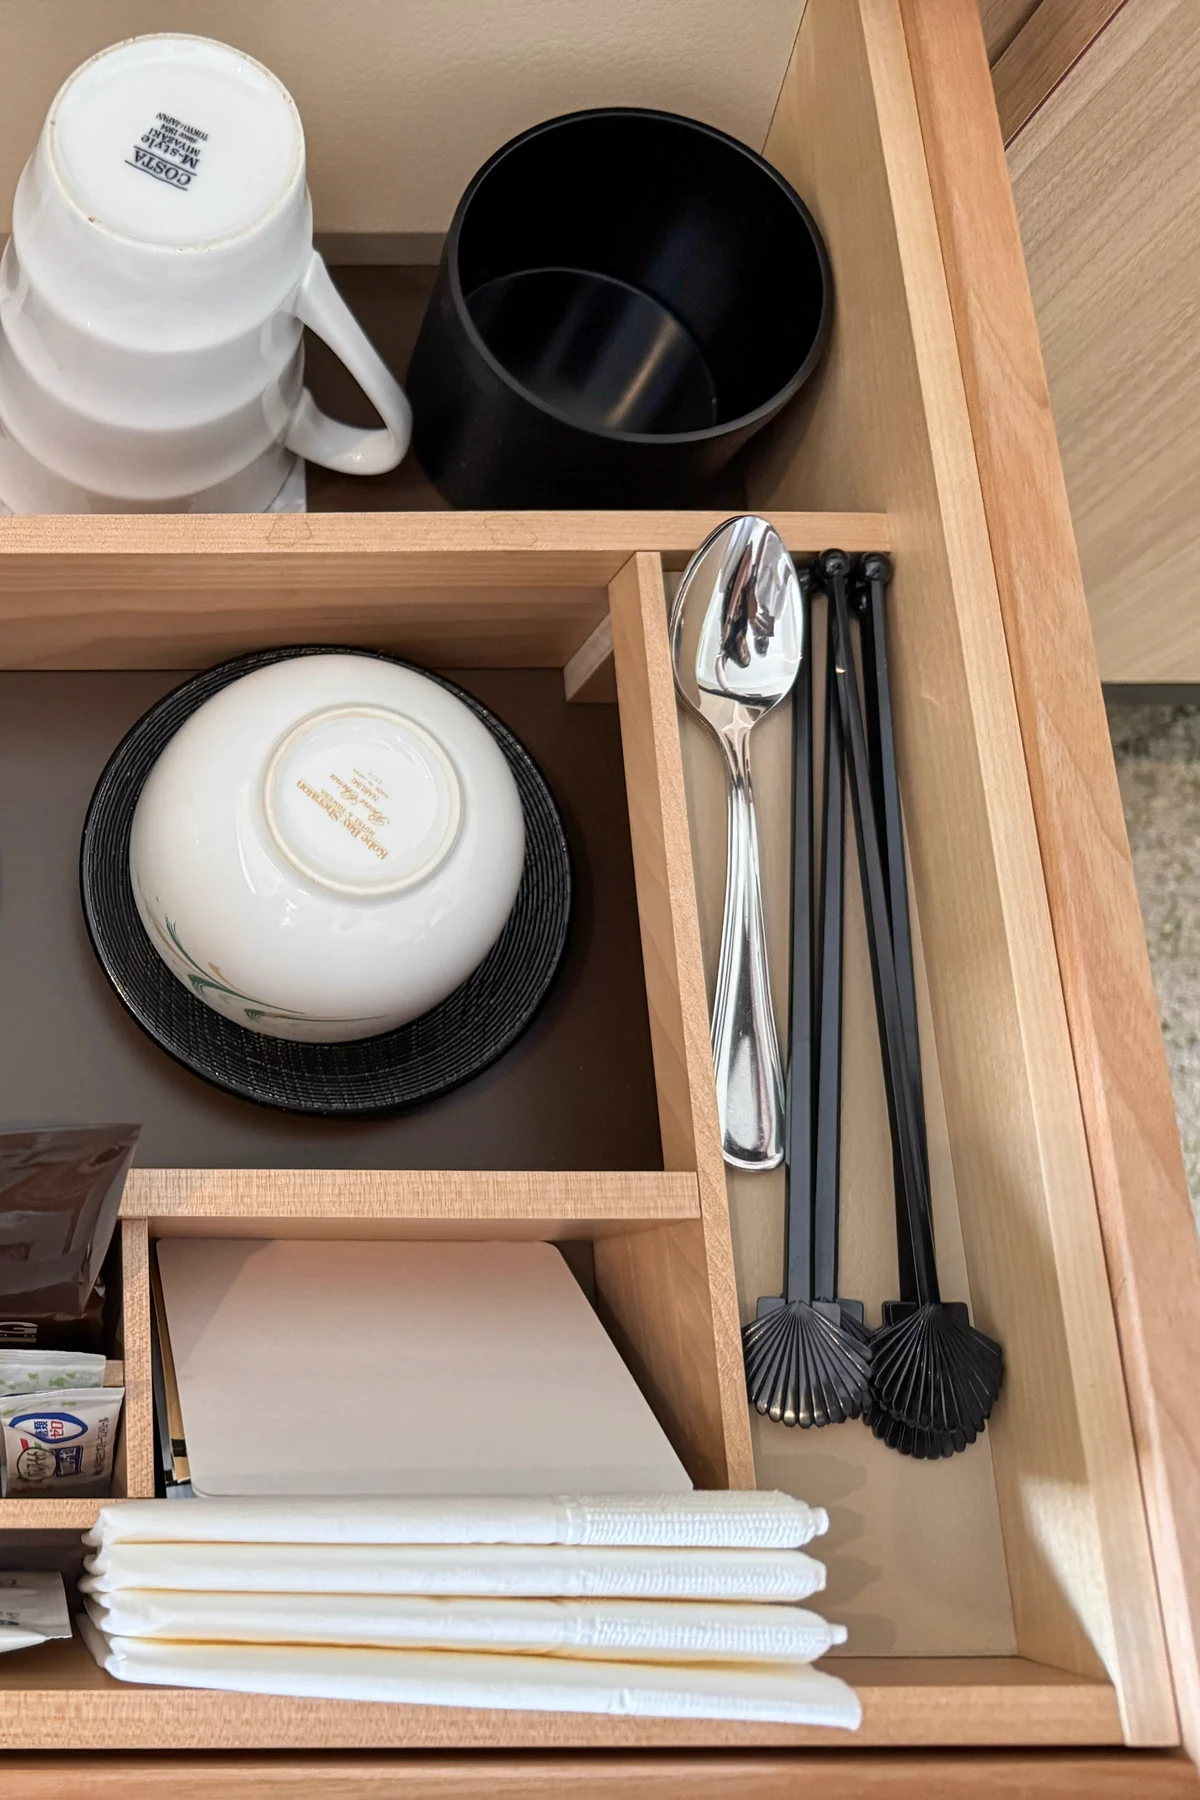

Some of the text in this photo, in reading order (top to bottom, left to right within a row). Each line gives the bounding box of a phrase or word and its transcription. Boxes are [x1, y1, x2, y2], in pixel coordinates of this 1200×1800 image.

[140, 134, 200, 170] M-style
[148, 127, 201, 157] MIYAZAKI
[134, 150, 192, 186] COSTA
[296, 779, 389, 860] Kobe Bay Sheraton
[49, 1420, 64, 1438] ゼロ
